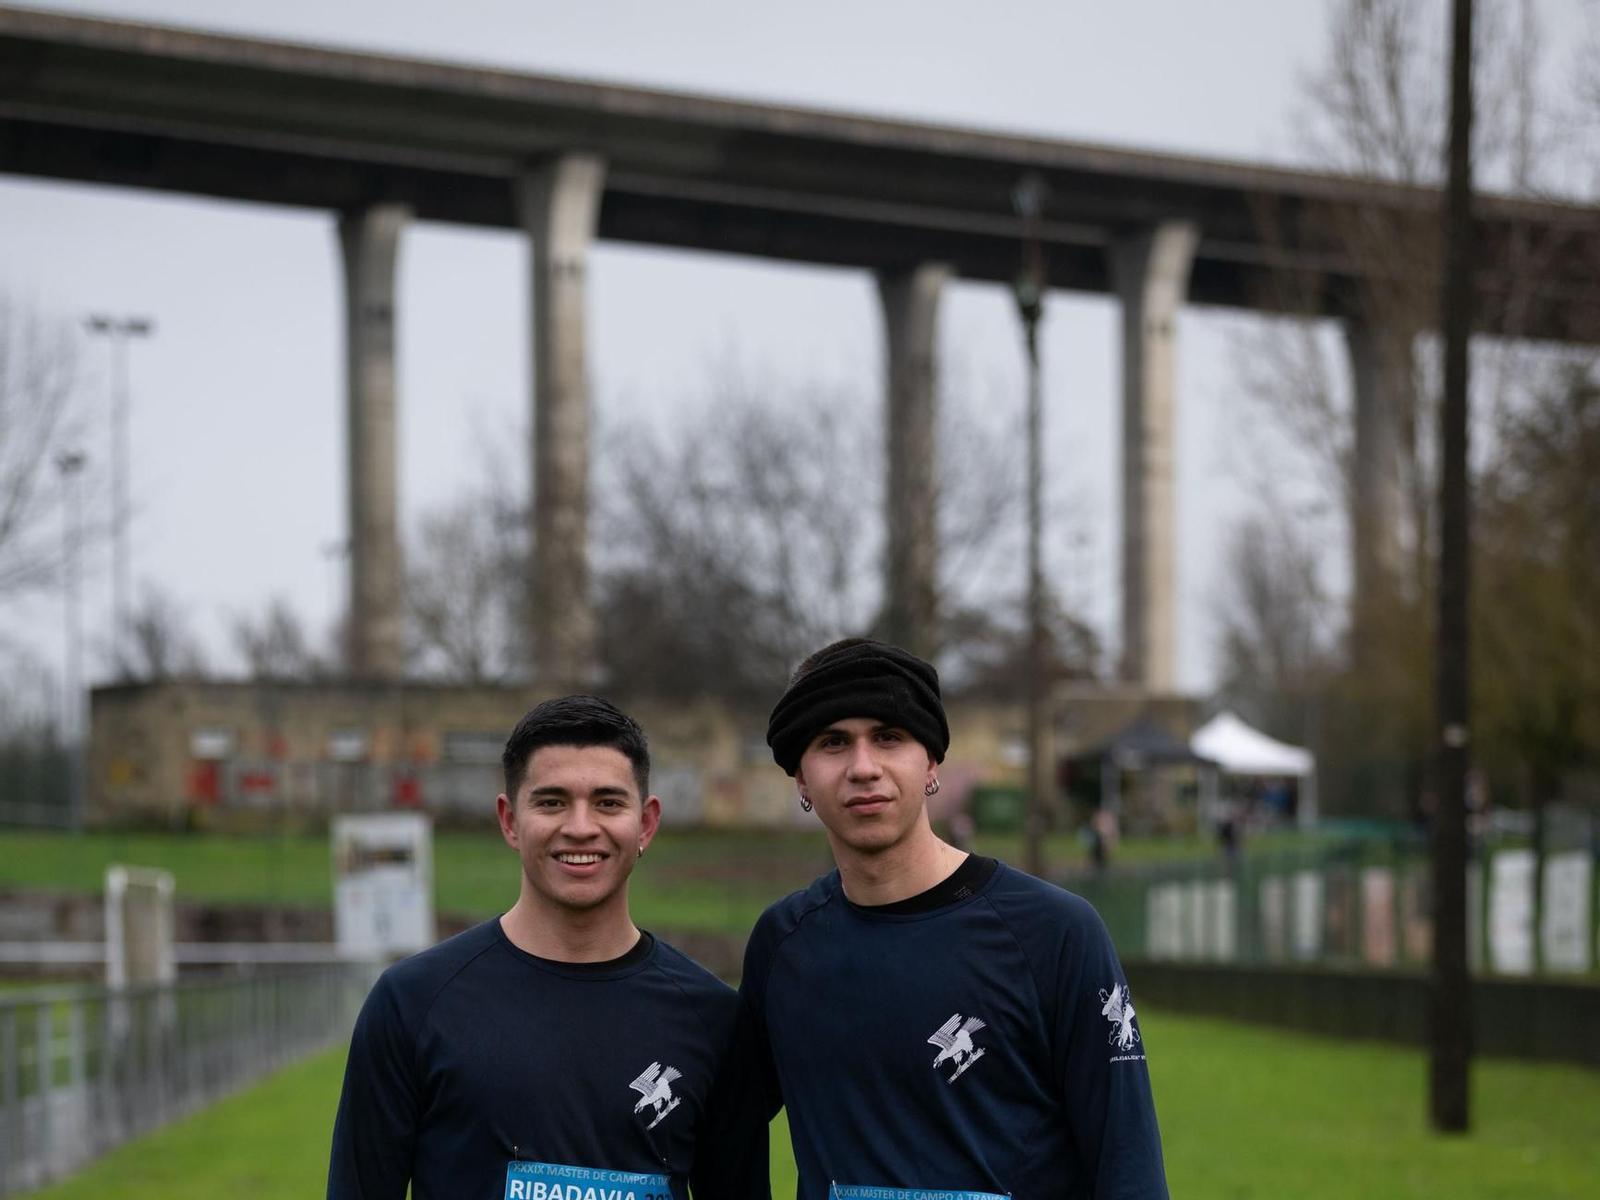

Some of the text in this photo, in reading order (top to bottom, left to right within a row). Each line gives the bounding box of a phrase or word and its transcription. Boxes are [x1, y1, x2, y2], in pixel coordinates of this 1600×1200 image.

[547, 1166, 590, 1180] MASTER
[593, 1171, 606, 1181] DE
[609, 1172, 647, 1186] CAMPO
[649, 1176, 656, 1187] A
[860, 1188, 895, 1200] MASTER
[897, 1190, 911, 1200] DE
